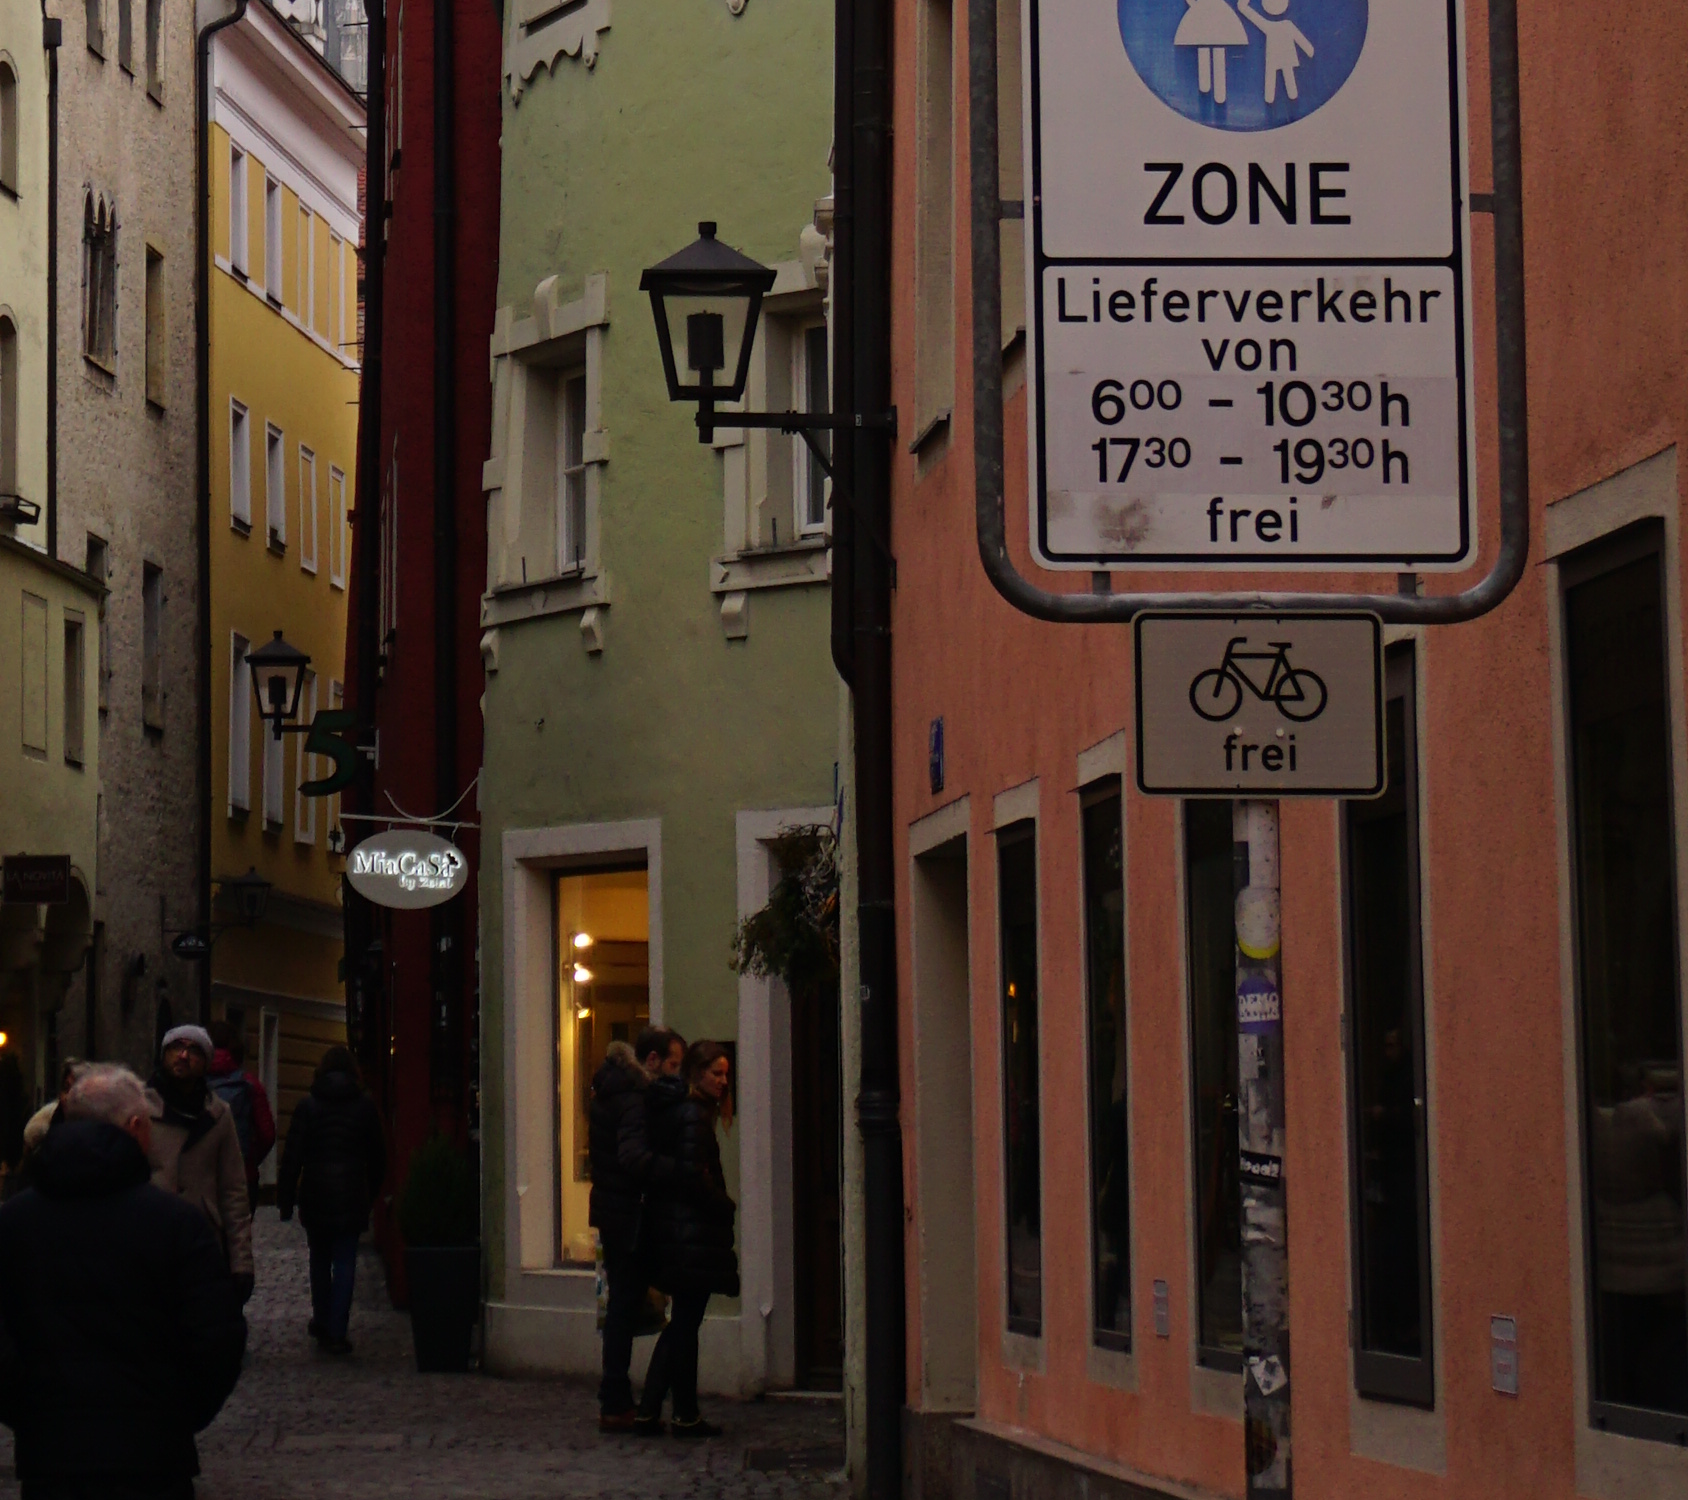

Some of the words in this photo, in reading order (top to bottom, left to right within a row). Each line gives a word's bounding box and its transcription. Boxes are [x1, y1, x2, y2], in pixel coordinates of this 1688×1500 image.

[1143, 162, 1352, 226] ZONE
[1057, 277, 1442, 323] Lieferverkehr
[1201, 338, 1297, 372] von
[1207, 497, 1298, 543] frei
[1223, 731, 1298, 774] frei
